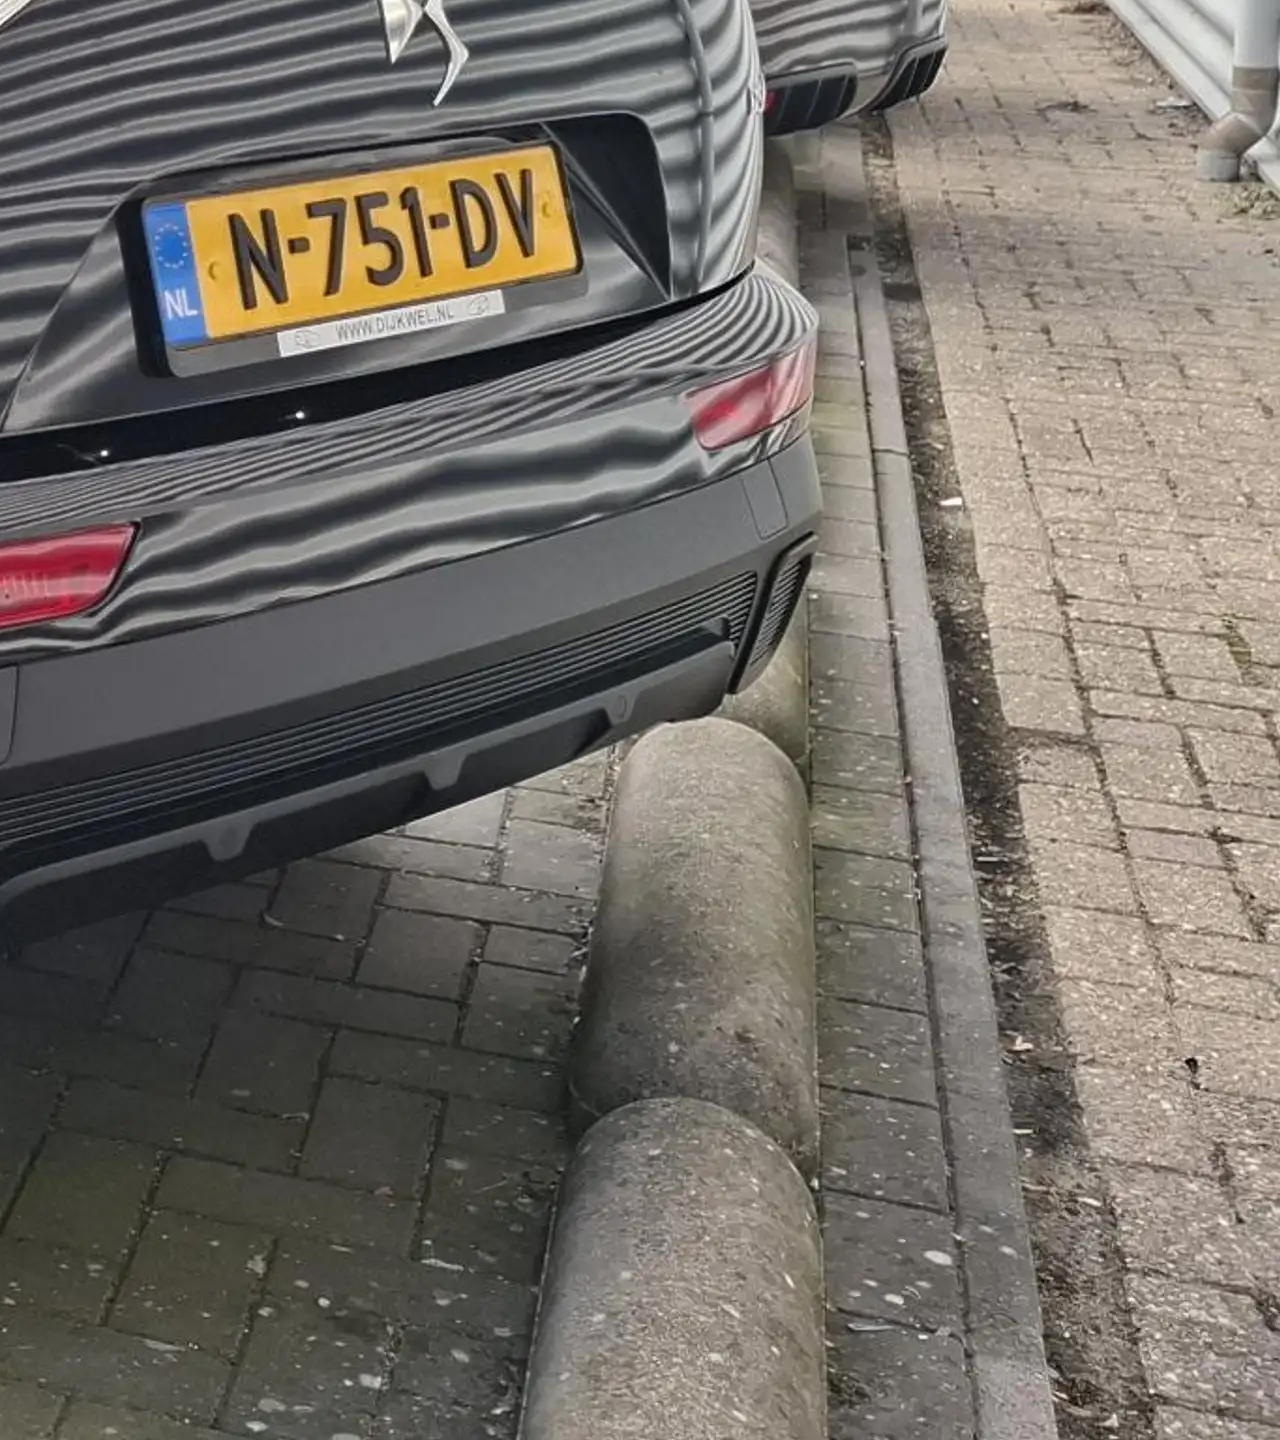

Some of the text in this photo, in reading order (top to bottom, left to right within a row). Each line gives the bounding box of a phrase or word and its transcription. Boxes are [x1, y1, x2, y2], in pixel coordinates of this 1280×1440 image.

[228, 169, 536, 310] N-751-DV
[165, 289, 199, 318] NL
[335, 303, 455, 339] WWW.DIJKWEL.NL
